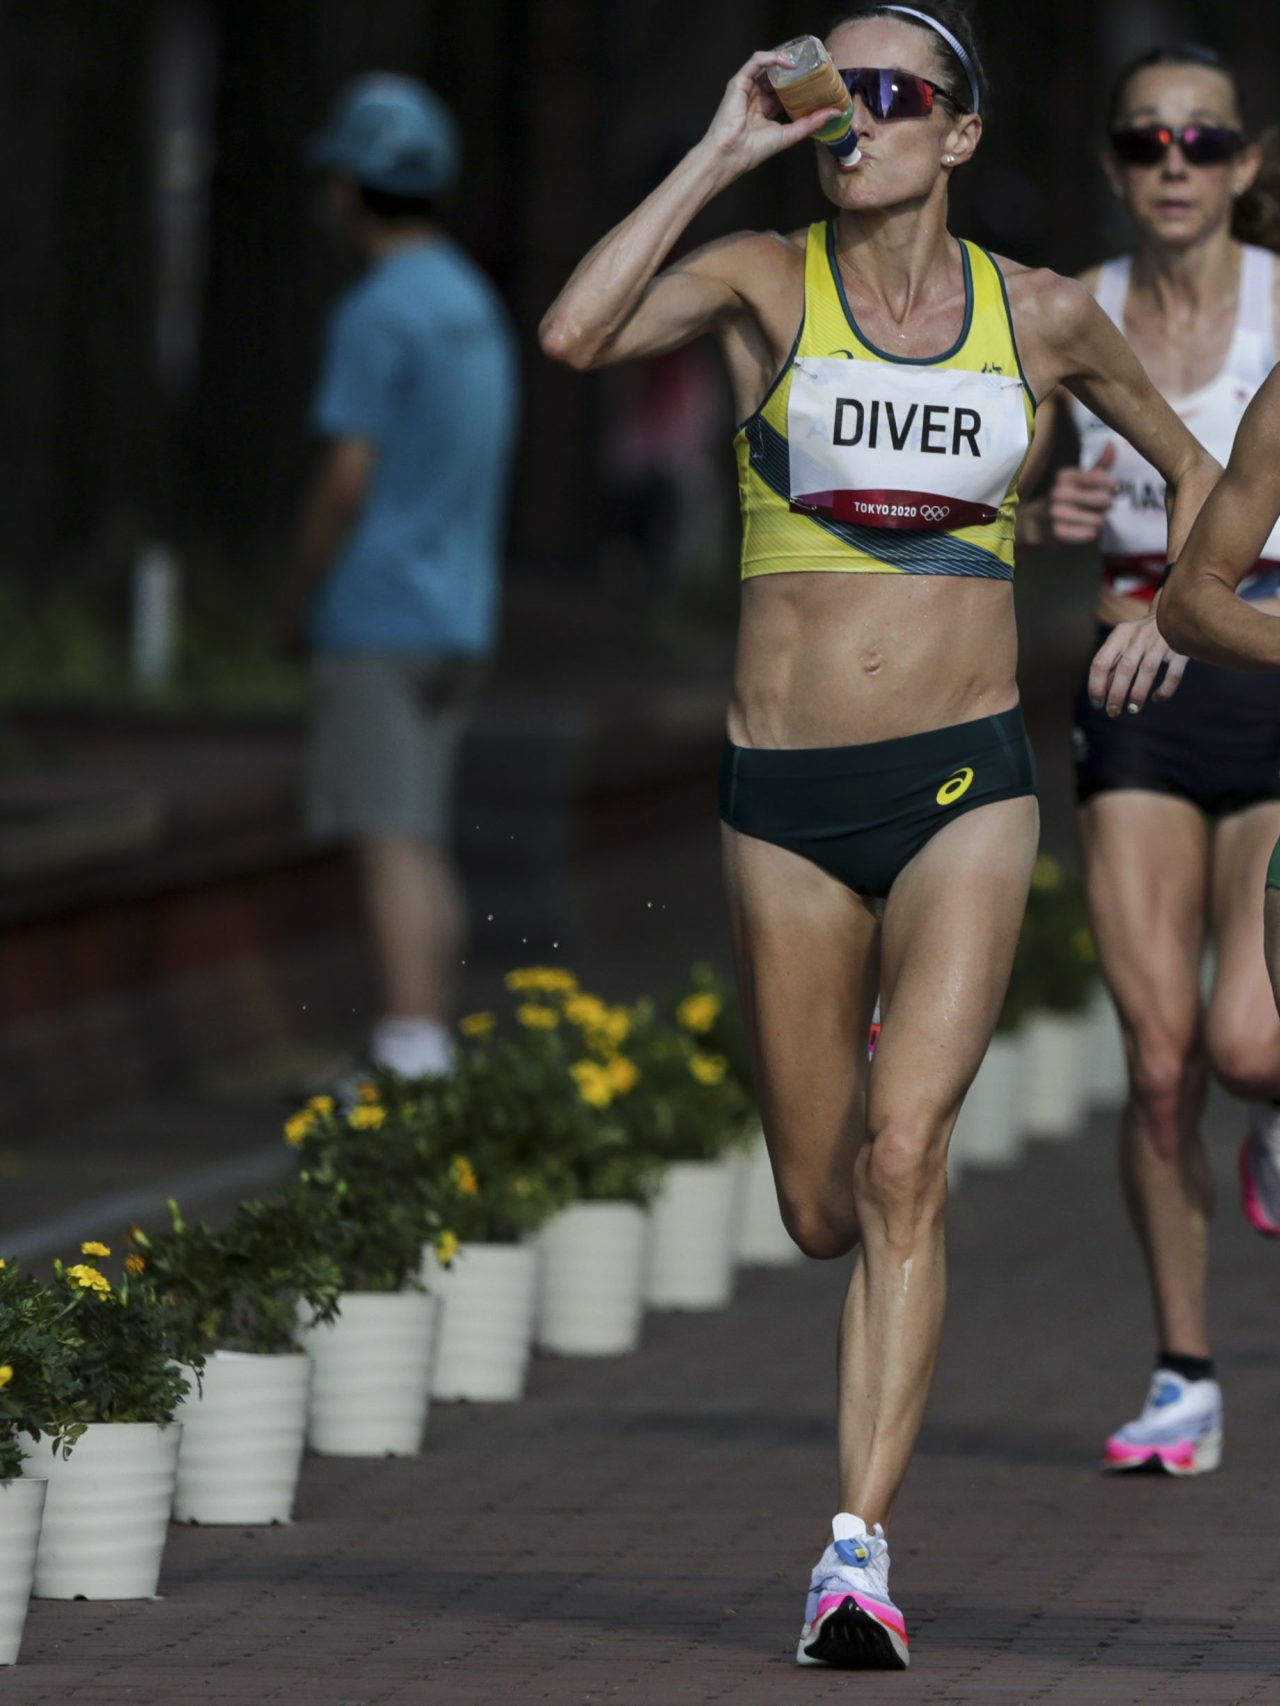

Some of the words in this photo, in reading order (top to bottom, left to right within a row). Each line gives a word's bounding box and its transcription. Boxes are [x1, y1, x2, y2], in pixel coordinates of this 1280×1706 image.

[833, 397, 982, 458] DIVER
[854, 501, 889, 515] TOKYO
[890, 505, 917, 517] 2020
